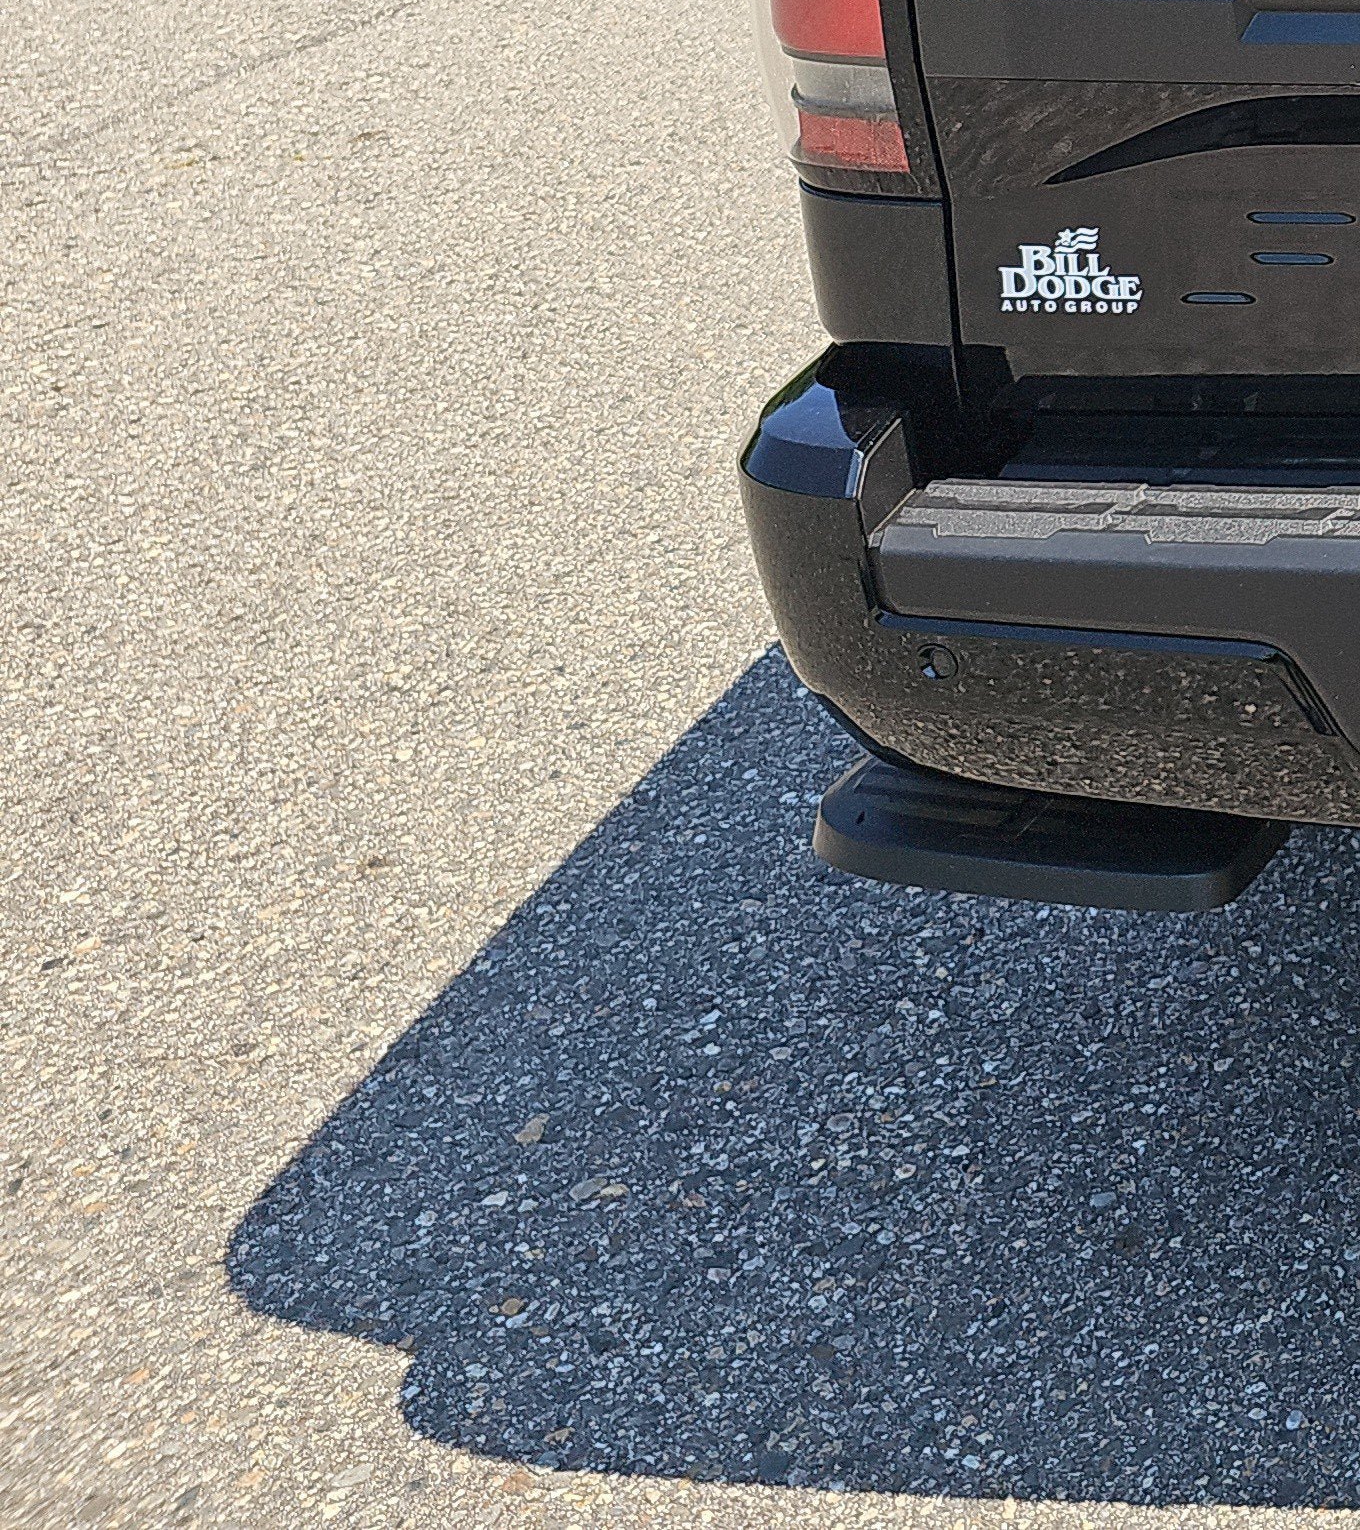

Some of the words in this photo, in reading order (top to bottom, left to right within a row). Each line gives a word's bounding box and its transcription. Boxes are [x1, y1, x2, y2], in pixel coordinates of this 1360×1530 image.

[1018, 244, 1111, 277] BILL
[998, 266, 1143, 301] DODGE
[1000, 299, 1058, 313] AUTO
[1064, 300, 1139, 314] GROUP
